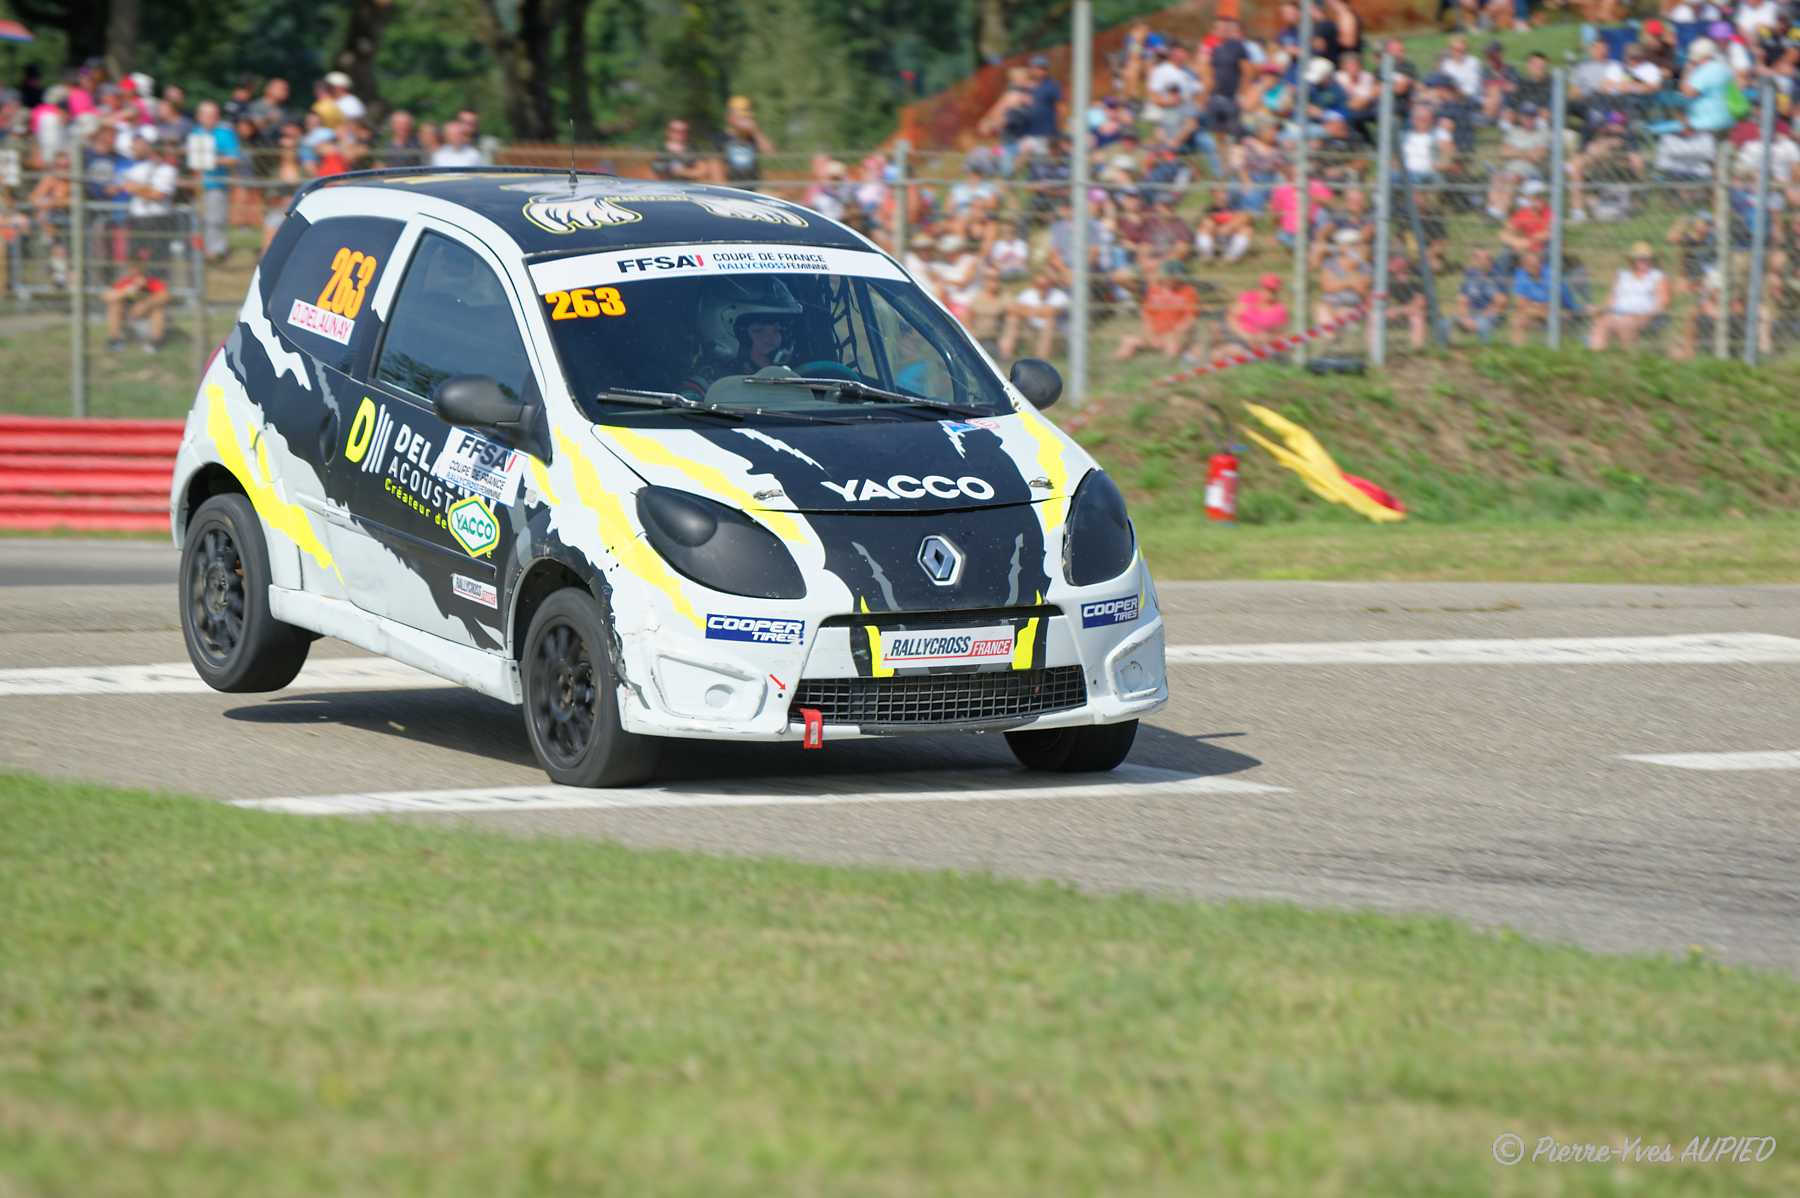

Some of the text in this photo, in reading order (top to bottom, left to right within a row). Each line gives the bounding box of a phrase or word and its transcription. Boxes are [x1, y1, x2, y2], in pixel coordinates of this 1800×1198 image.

[617, 252, 825, 273] FFSA COUPE DE FRANCE
[315, 247, 377, 319] 263
[544, 287, 628, 321] 263
[456, 434, 508, 472] FFSA
[449, 460, 472, 477] COUPE
[480, 471, 506, 490] FRANCE
[820, 475, 996, 502] YACCO
[385, 477, 448, 529] Créateur de
[455, 511, 493, 540] YACCO
[1083, 597, 1138, 618] COOPER
[1113, 610, 1137, 622] TIRES
[707, 616, 803, 634] COOPER
[751, 631, 800, 643] TIRES
[890, 636, 1011, 657] RALLYCROSS FRANCE
